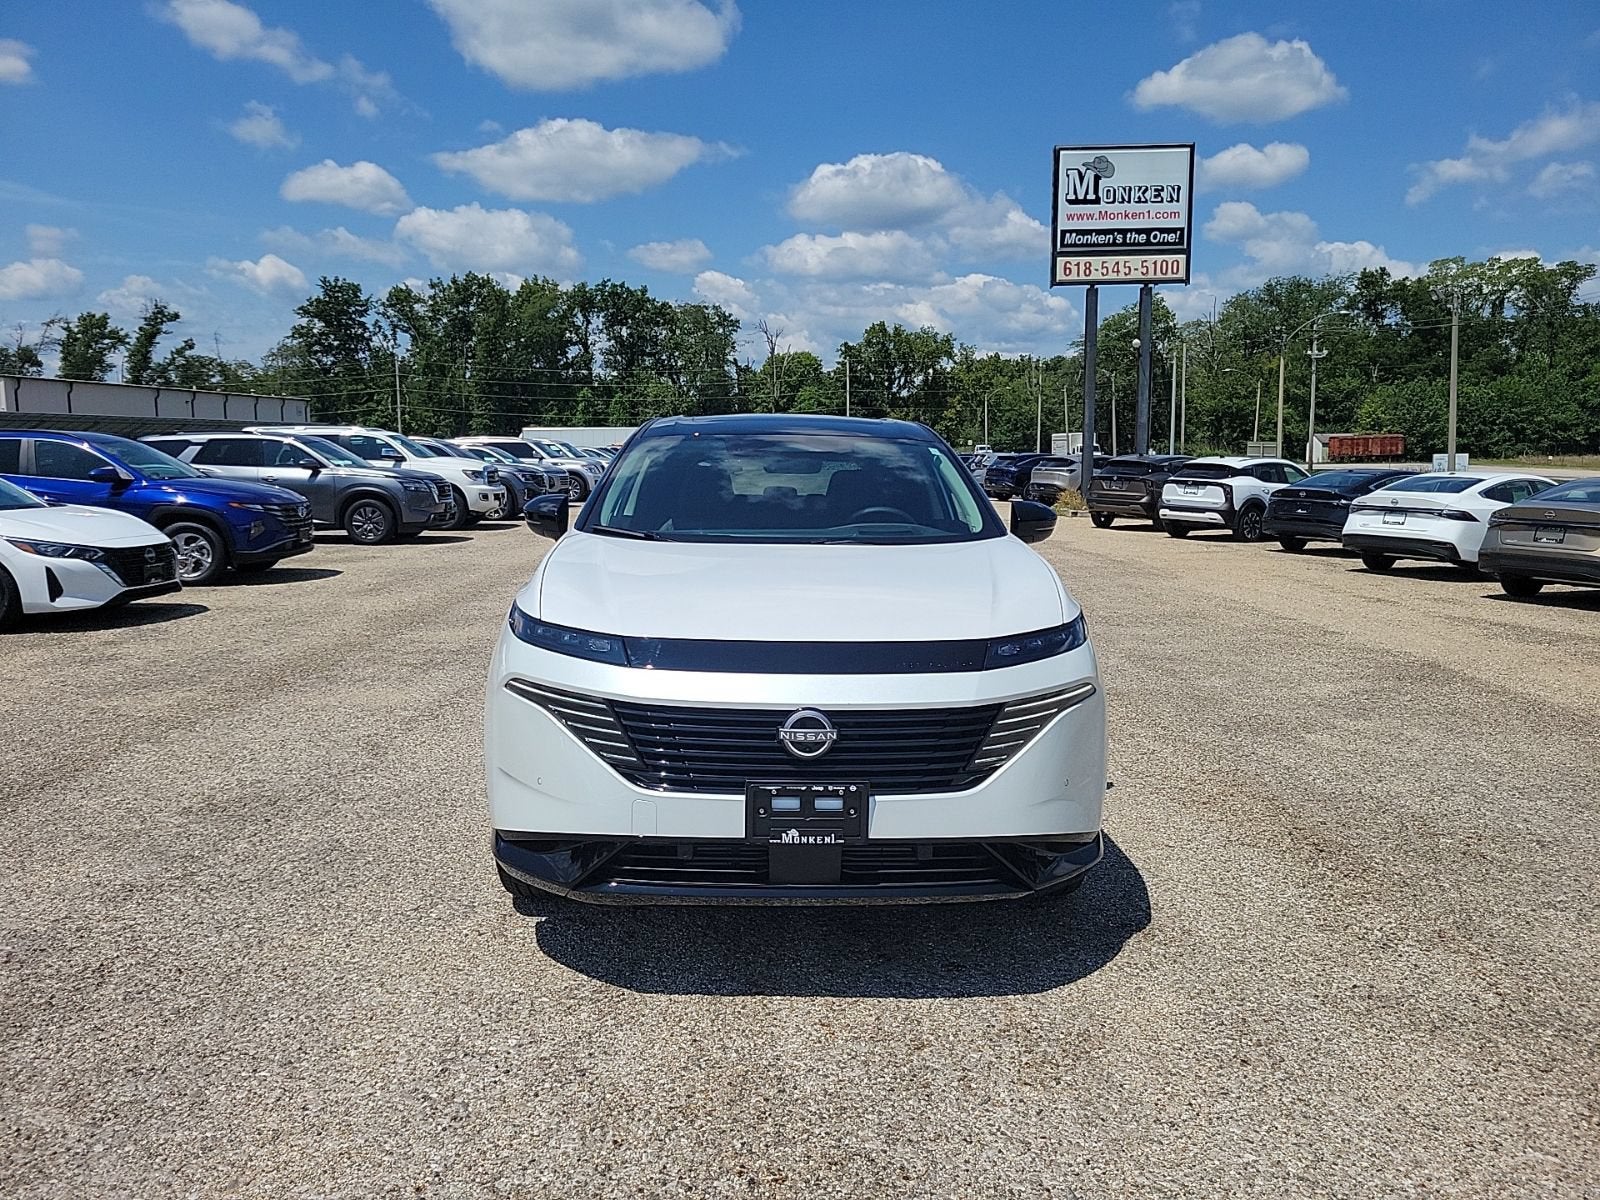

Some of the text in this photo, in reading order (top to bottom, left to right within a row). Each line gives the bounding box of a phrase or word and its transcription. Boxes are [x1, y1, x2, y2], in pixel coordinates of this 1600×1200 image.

[1066, 210, 1180, 221] www.Monken1.com
[1064, 231, 1181, 245] Monken's the One!
[1063, 259, 1180, 277] 618-545-5100
[780, 731, 837, 741] NISSAN
